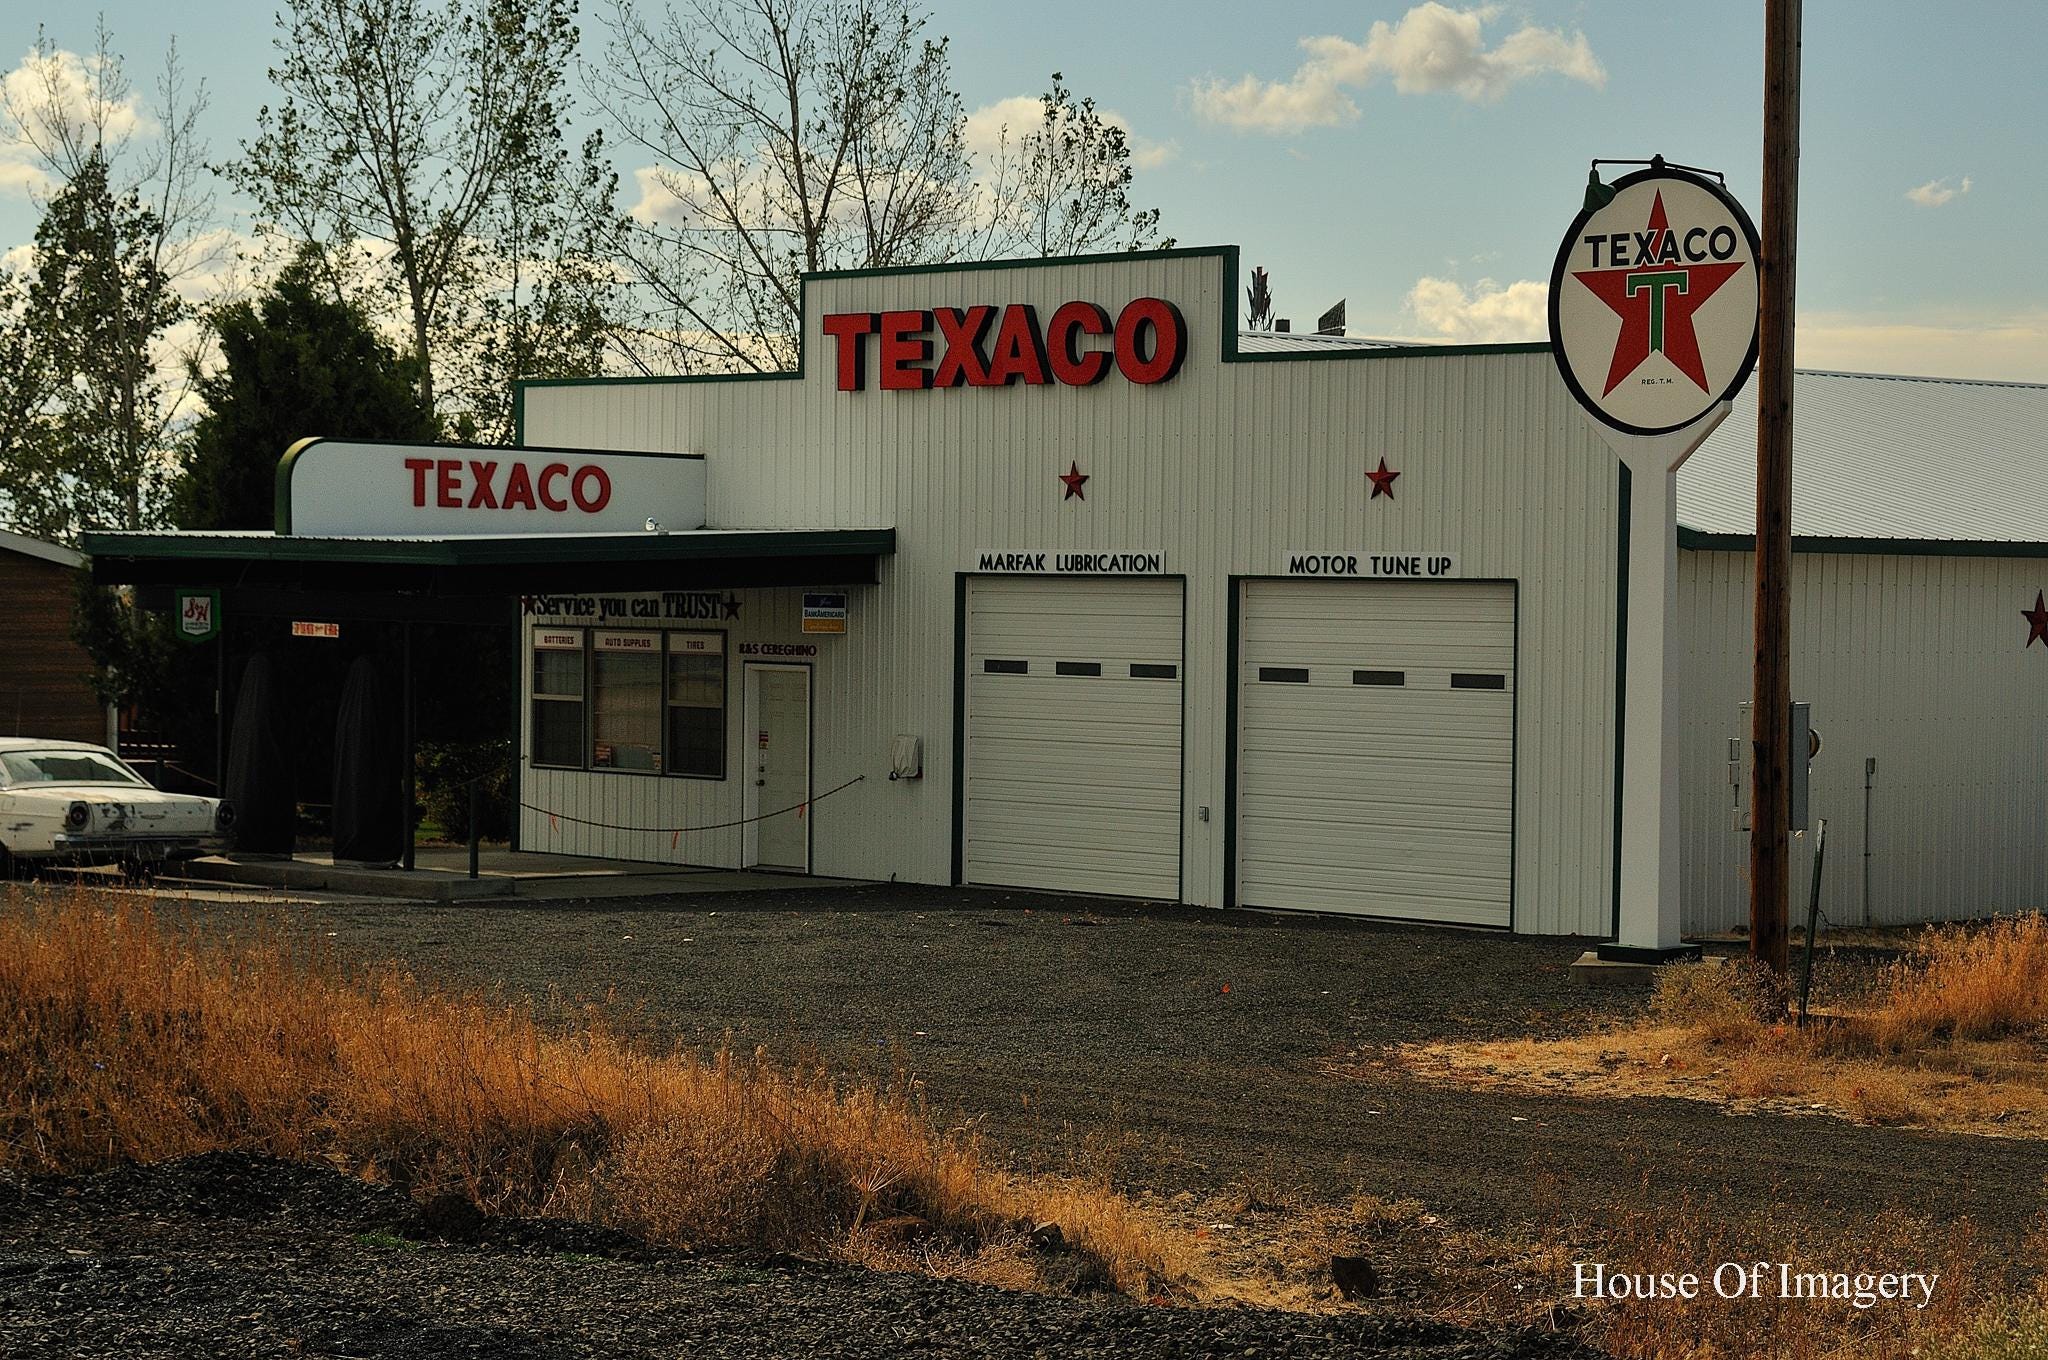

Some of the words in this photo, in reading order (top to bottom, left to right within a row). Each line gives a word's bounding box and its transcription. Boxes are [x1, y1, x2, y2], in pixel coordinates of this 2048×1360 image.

[1583, 225, 1738, 268] TEXACO
[1626, 270, 1689, 354] T
[823, 297, 1188, 392] TEXACO
[405, 459, 612, 513] TEXACO
[979, 554, 1046, 572] MARFAK
[1056, 554, 1160, 573] LUBRICATION
[1289, 555, 1358, 576] MOTOR
[1370, 556, 1421, 576] TUNE
[1428, 556, 1452, 576] UP
[537, 594, 595, 616] Service
[598, 597, 627, 621] you
[631, 598, 660, 618] can
[662, 592, 721, 619] TRUST
[544, 635, 575, 645] BATTERIES
[605, 638, 621, 647] AUTO
[623, 638, 651, 648] SUPPLIES
[686, 641, 705, 650] TIRES
[760, 644, 817, 657] CEREGHINO
